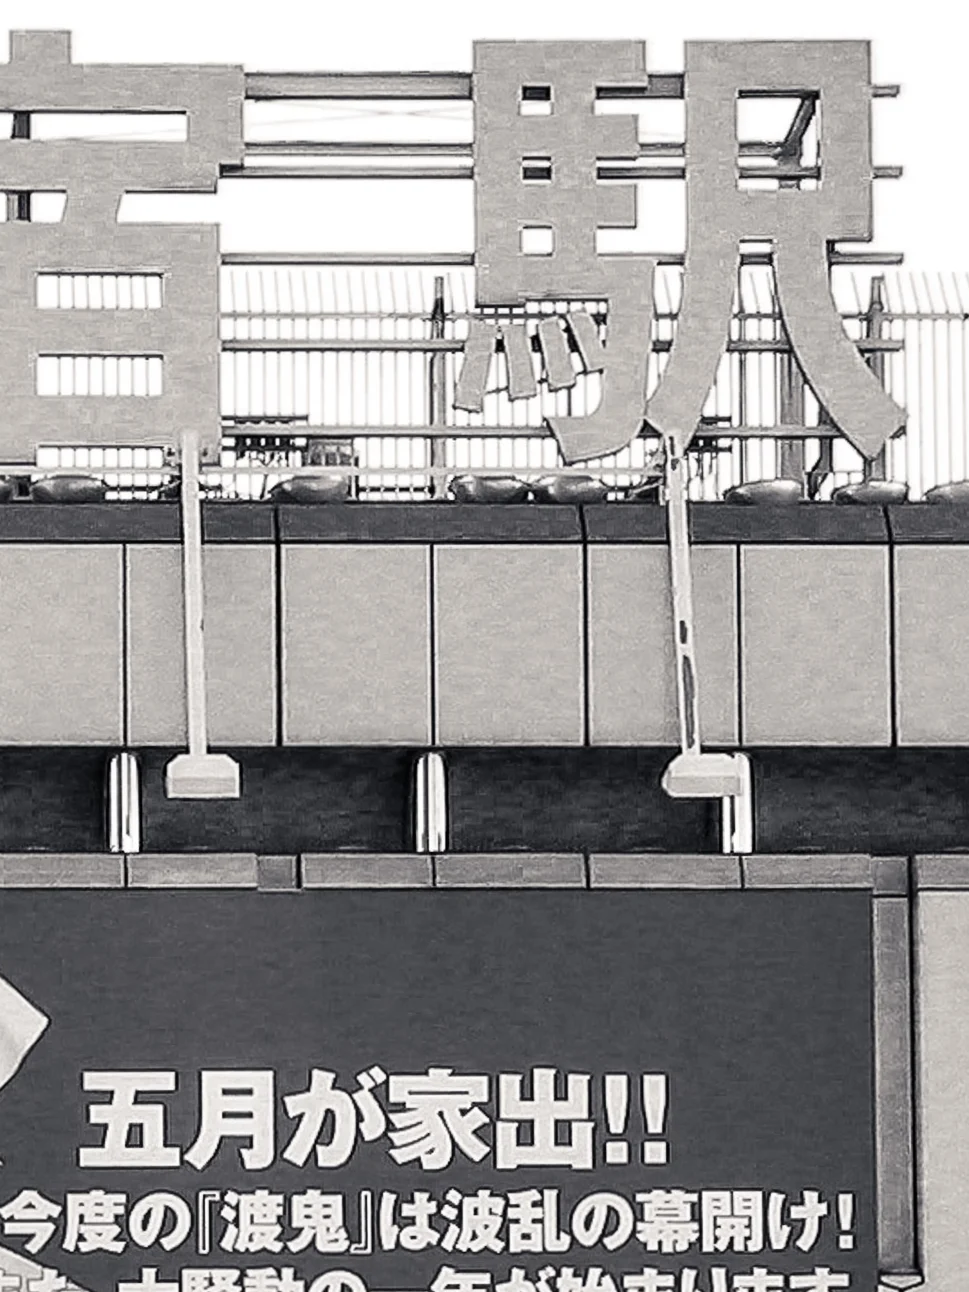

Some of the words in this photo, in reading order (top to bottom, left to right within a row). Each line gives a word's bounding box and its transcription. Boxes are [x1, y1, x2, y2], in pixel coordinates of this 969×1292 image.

[78, 1068, 668, 1171] 五月が家出!!
